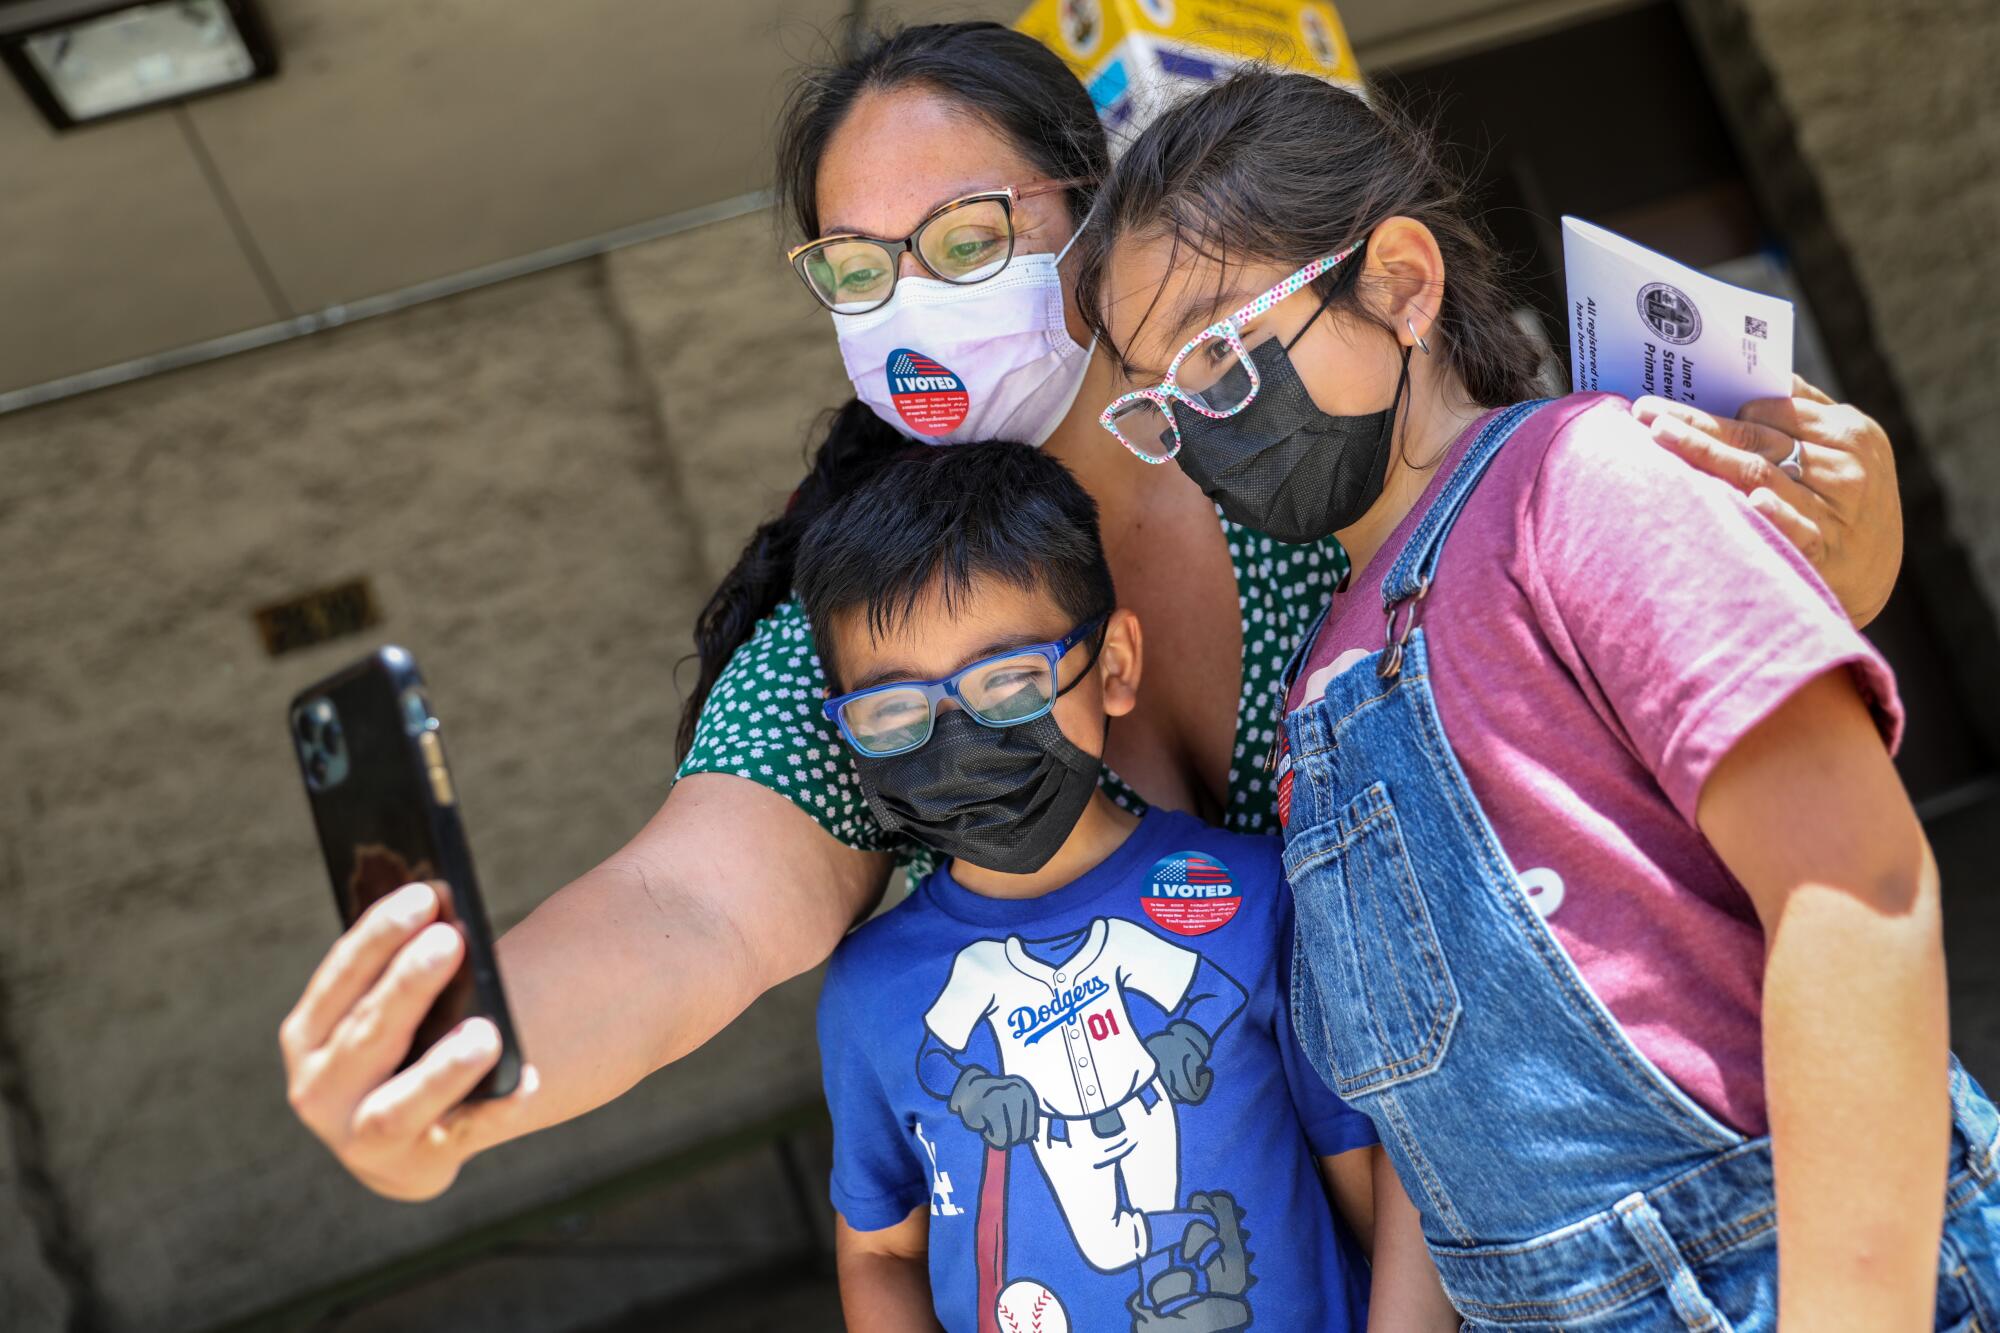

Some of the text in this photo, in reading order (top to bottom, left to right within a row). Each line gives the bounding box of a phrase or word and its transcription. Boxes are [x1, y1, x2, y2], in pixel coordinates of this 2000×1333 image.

[1576, 301, 1584, 330] have
[1587, 296, 1597, 316] All
[1577, 332, 1585, 360] been
[1586, 317, 1599, 377] registered
[895, 376, 958, 392] I VOTED
[1642, 342, 1656, 395] Primary
[1663, 349, 1676, 400] Statewi
[1681, 356, 1695, 401] June 7,
[1152, 883, 1233, 898] I VOTED
[1007, 975, 1110, 1048] Dodgers
[1087, 1008, 1121, 1041] 01
